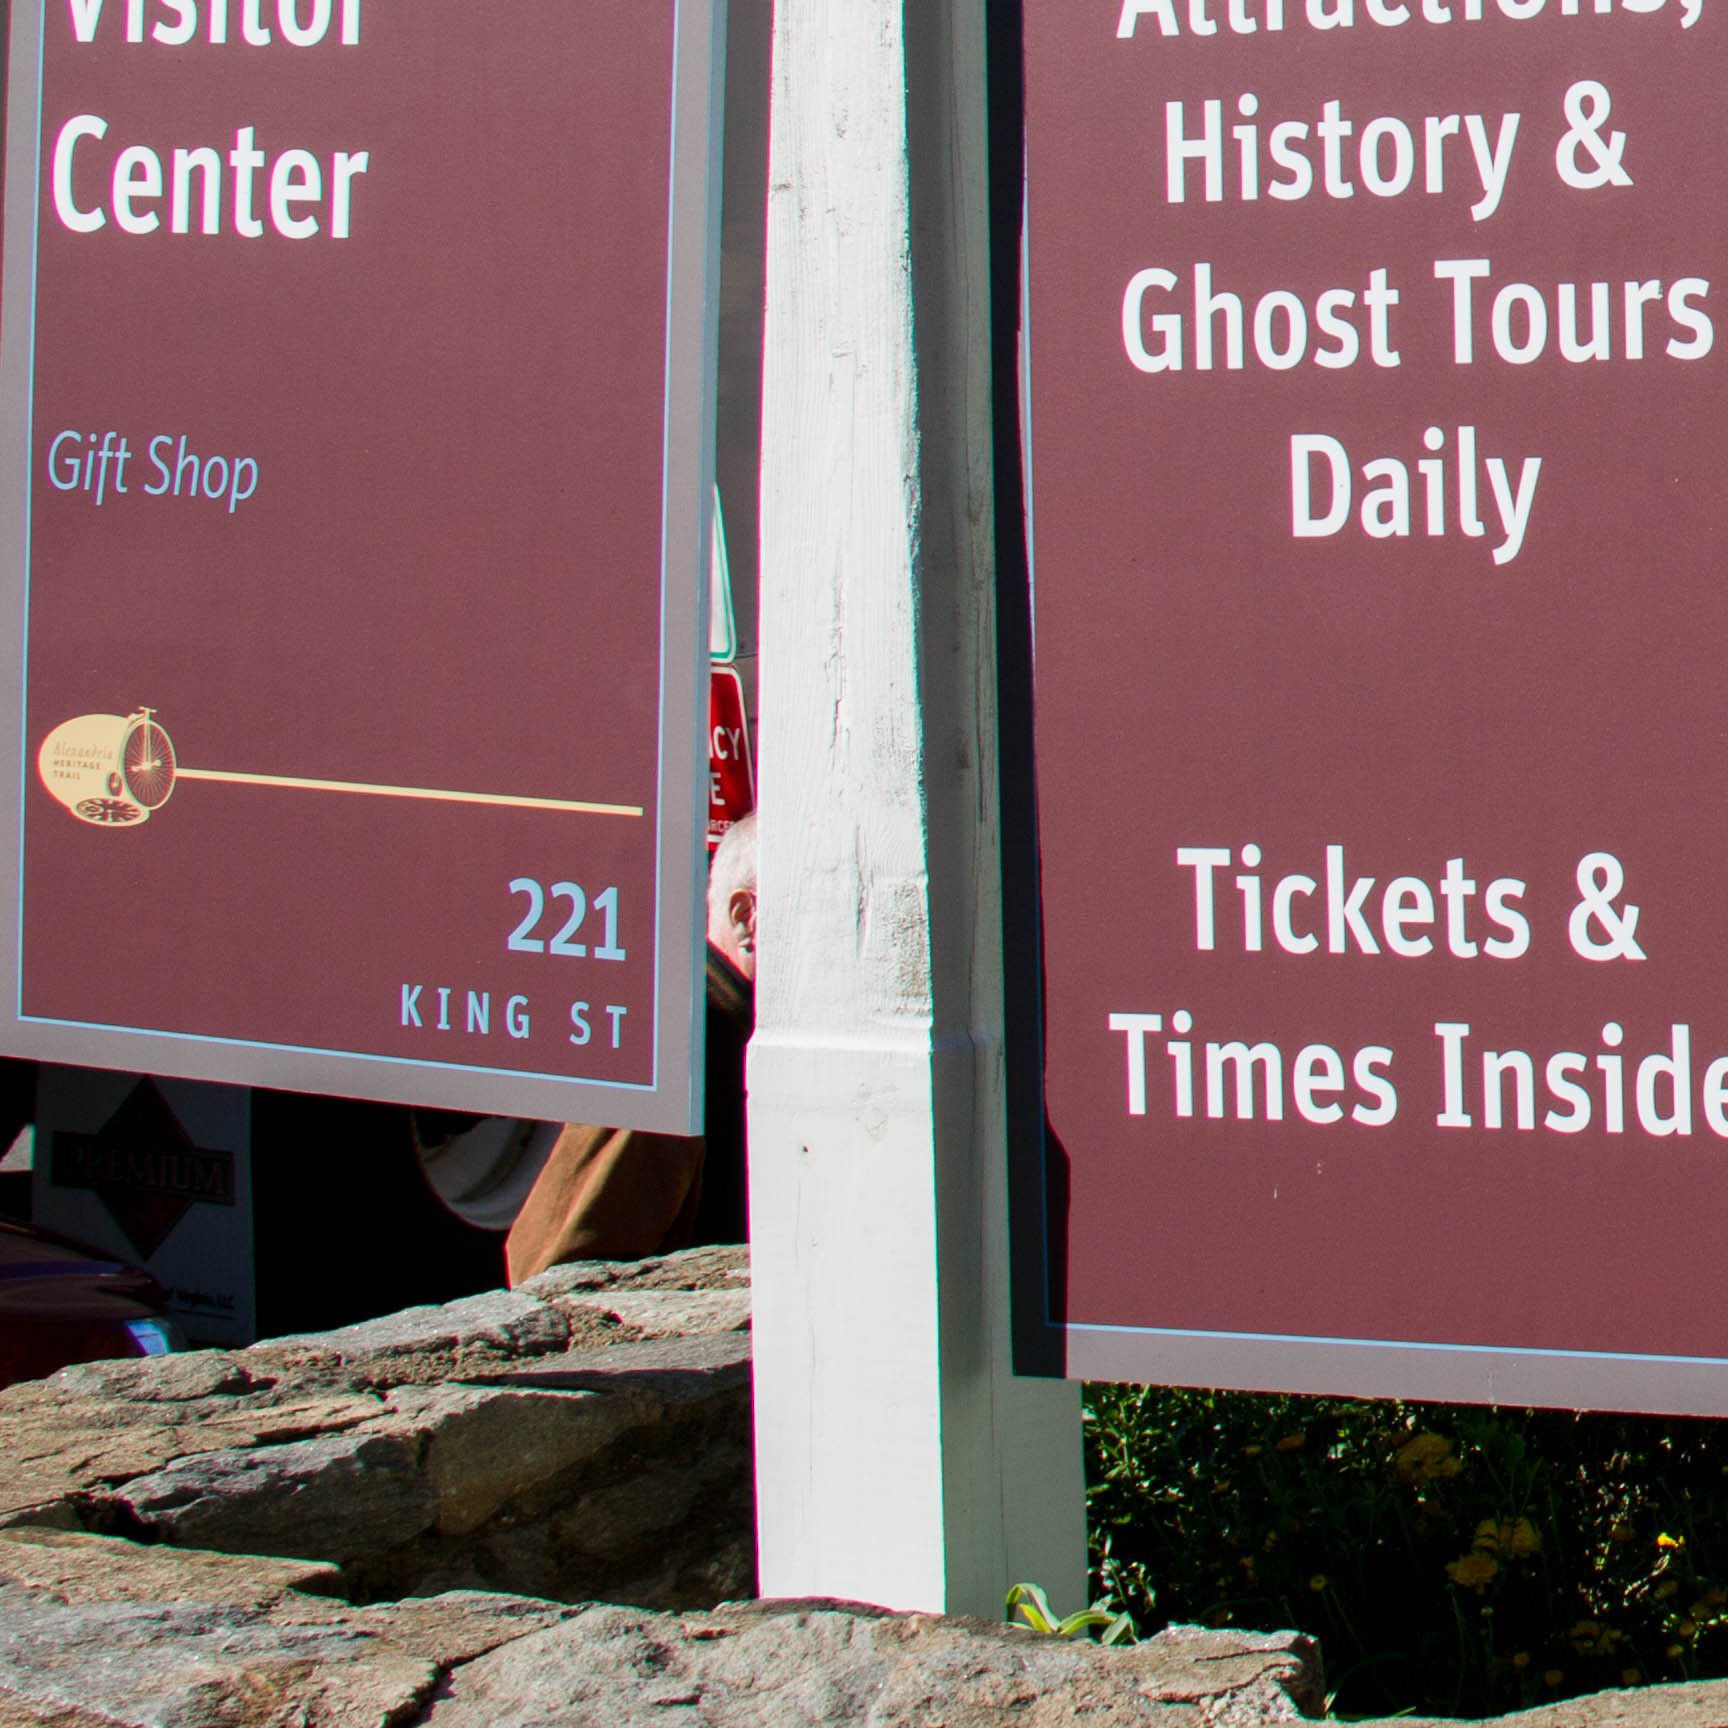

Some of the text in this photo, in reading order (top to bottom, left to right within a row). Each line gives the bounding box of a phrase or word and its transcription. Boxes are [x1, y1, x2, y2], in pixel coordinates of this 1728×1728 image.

[53, 114, 369, 239] Center
[1166, 80, 1634, 222] History &
[1122, 259, 1713, 373] Ghost Tours
[48, 430, 258, 513] Gift Shop
[1291, 426, 1542, 565] Daily
[507, 877, 626, 961] 221
[1177, 843, 1647, 961] Tickets &
[401, 983, 627, 1049] KING ST
[1109, 1010, 1397, 1126] Times
